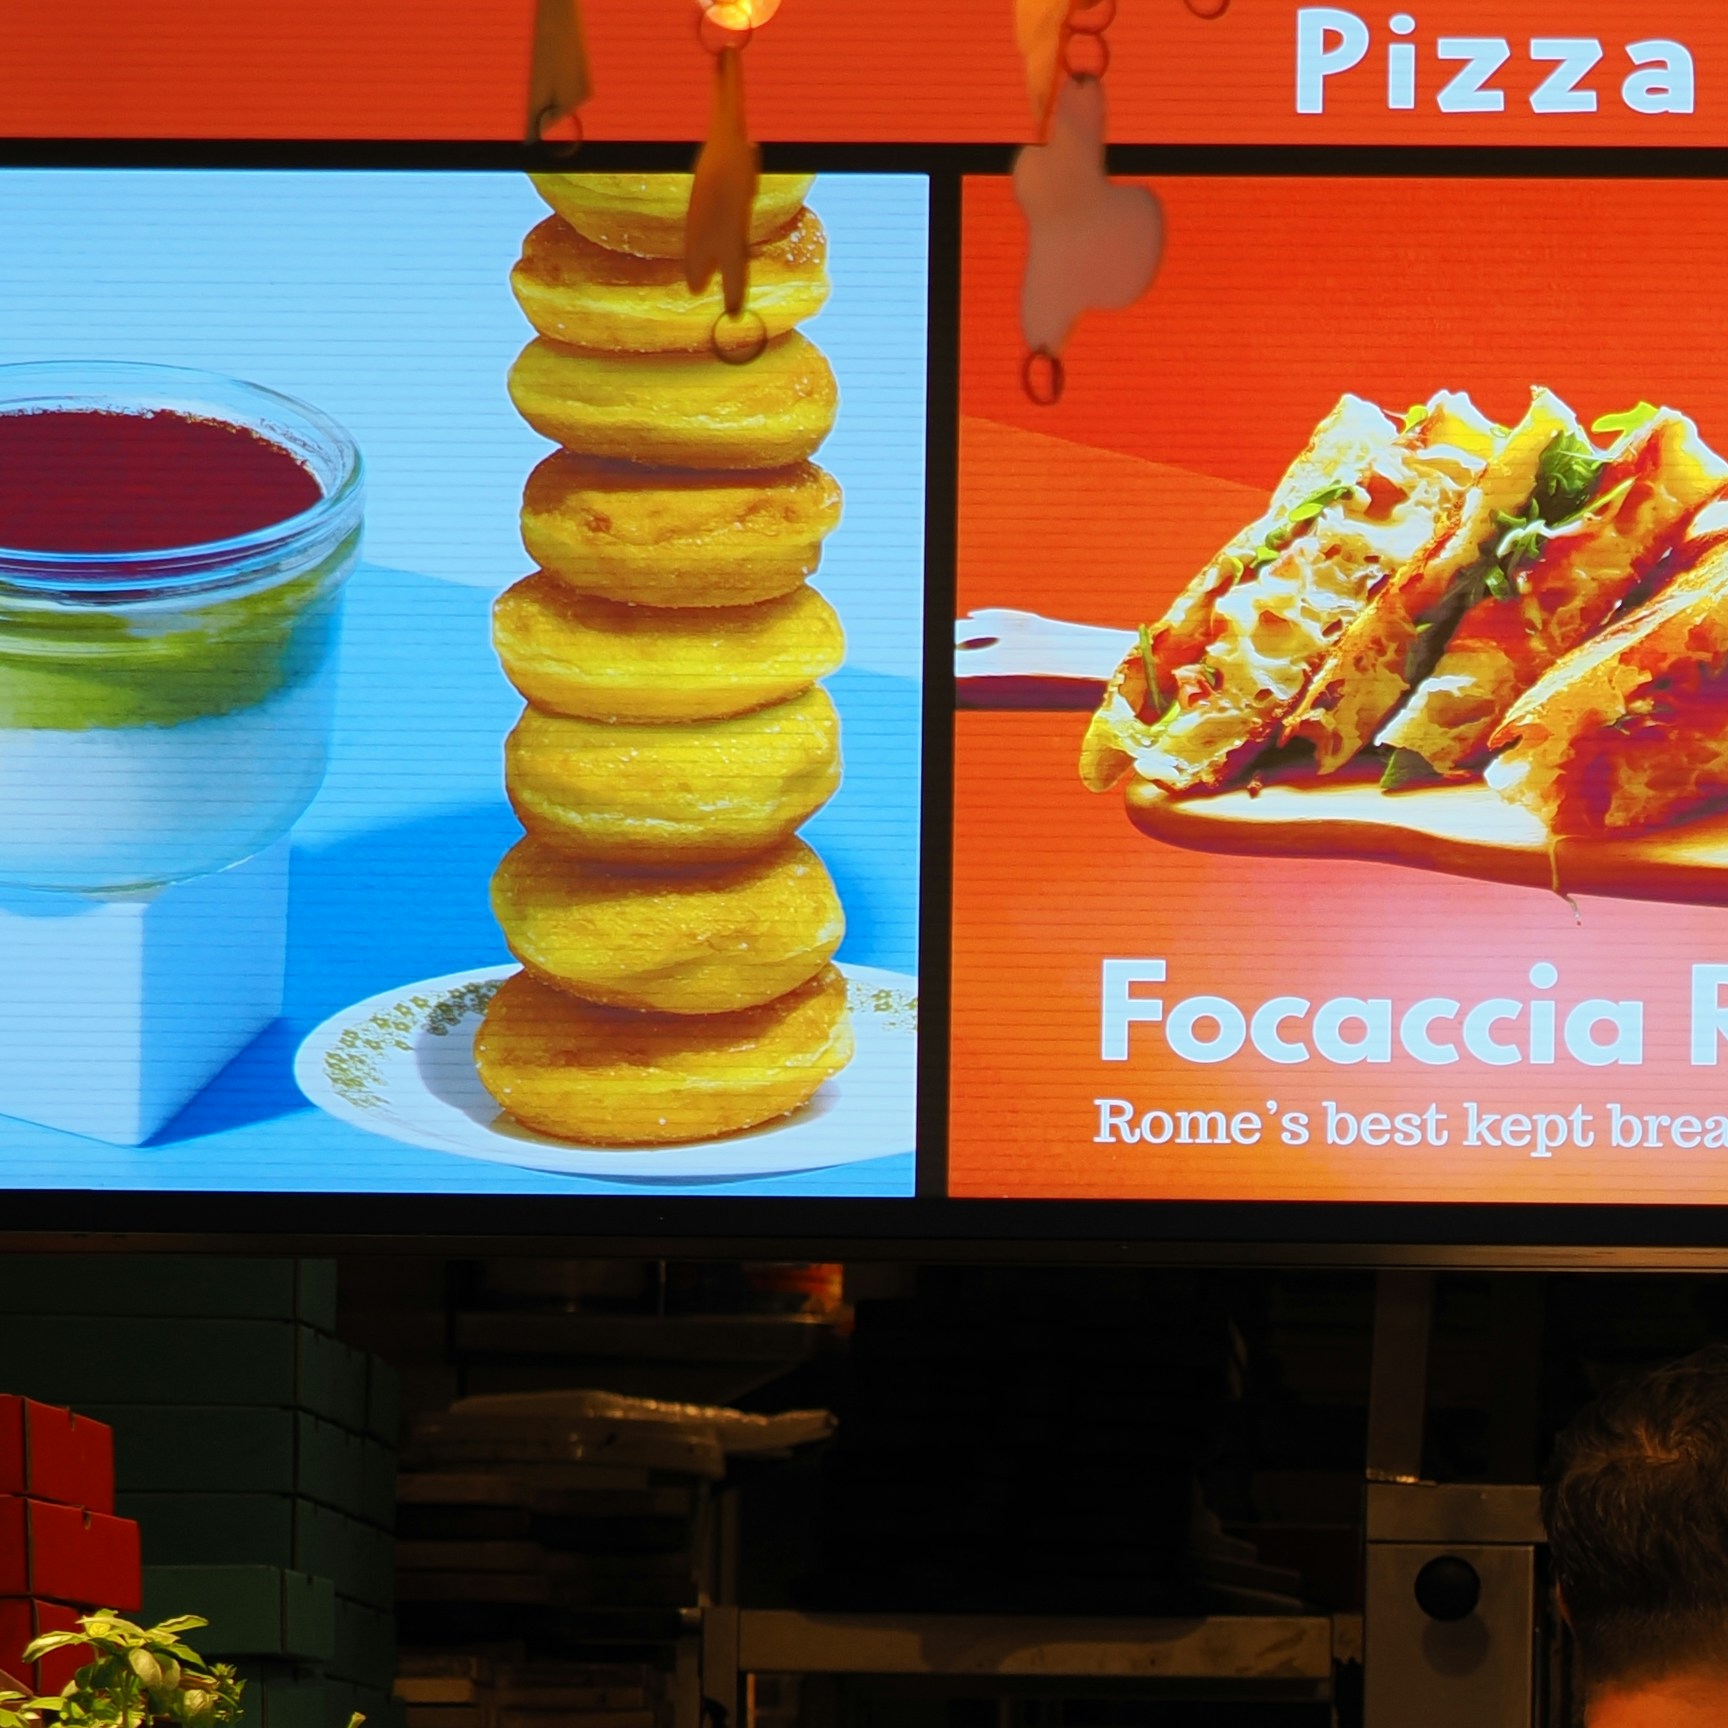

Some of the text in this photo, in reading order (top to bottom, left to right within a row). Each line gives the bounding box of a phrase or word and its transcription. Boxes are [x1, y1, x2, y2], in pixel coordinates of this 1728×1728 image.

[1295, 8, 1696, 115] Pizza
[1100, 958, 1644, 1067] Focaccia
[1093, 1098, 1310, 1146] Rome's
[1322, 1100, 1449, 1147] best
[1461, 1102, 1595, 1158] kept
